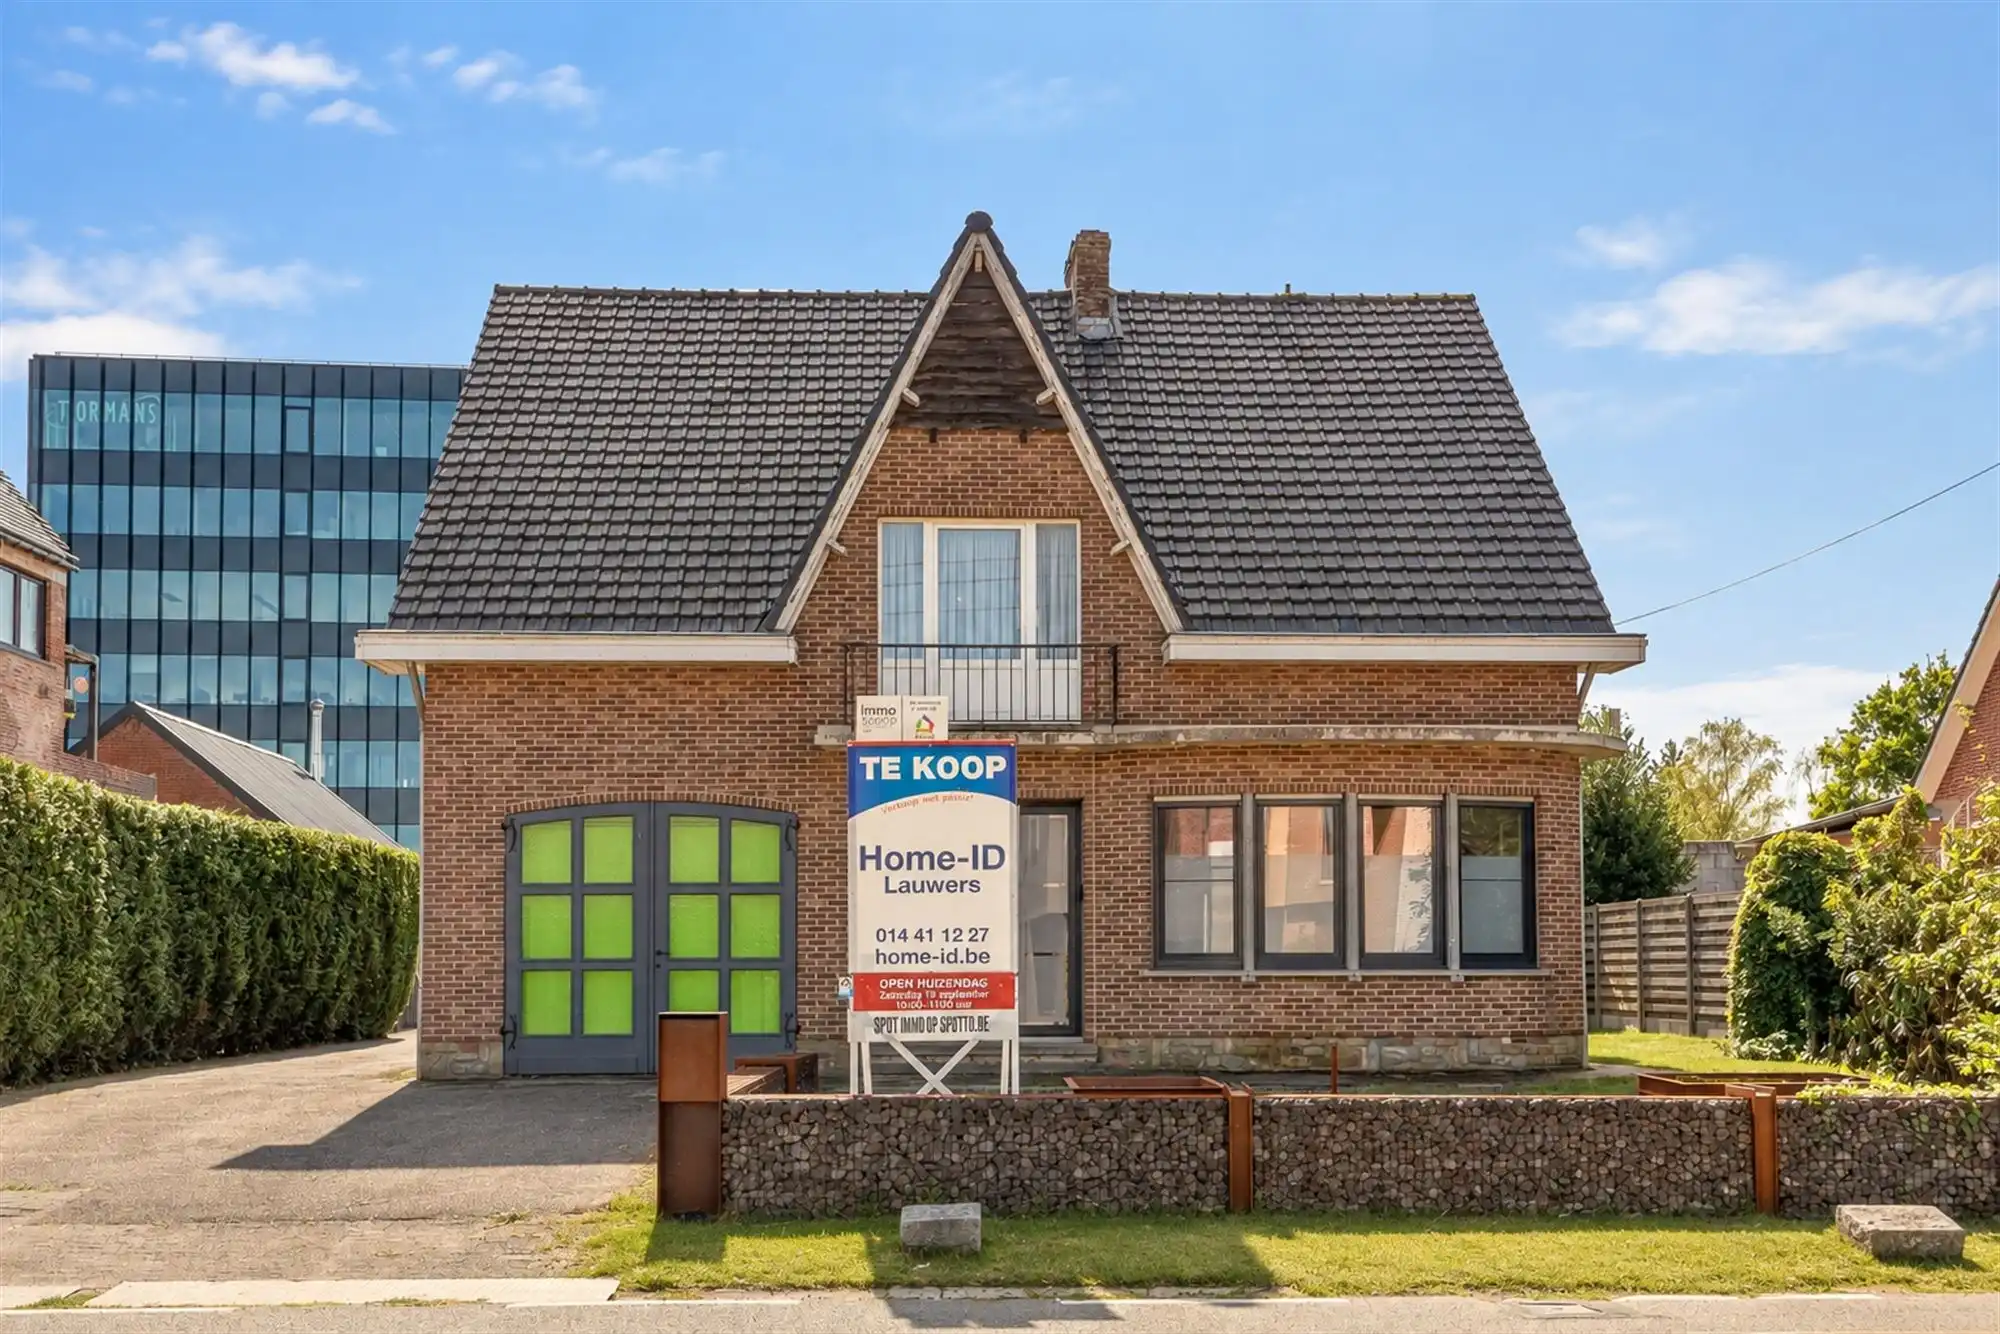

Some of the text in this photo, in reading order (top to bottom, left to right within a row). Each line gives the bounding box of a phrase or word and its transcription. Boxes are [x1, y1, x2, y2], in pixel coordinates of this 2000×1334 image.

[58, 400, 156, 423] TORMANS
[861, 704, 897, 716] Immo
[859, 755, 1007, 780] TE KOOP
[859, 844, 1006, 871] Home-ID
[884, 876, 981, 894] Lauwers
[876, 928, 989, 943] 014 41 12 27
[875, 948, 991, 965] home-id.be
[879, 978, 988, 989] OPEN HUIZENDAG
[873, 1015, 990, 1034] SPOT IMMO OP SPOTTO.BE
